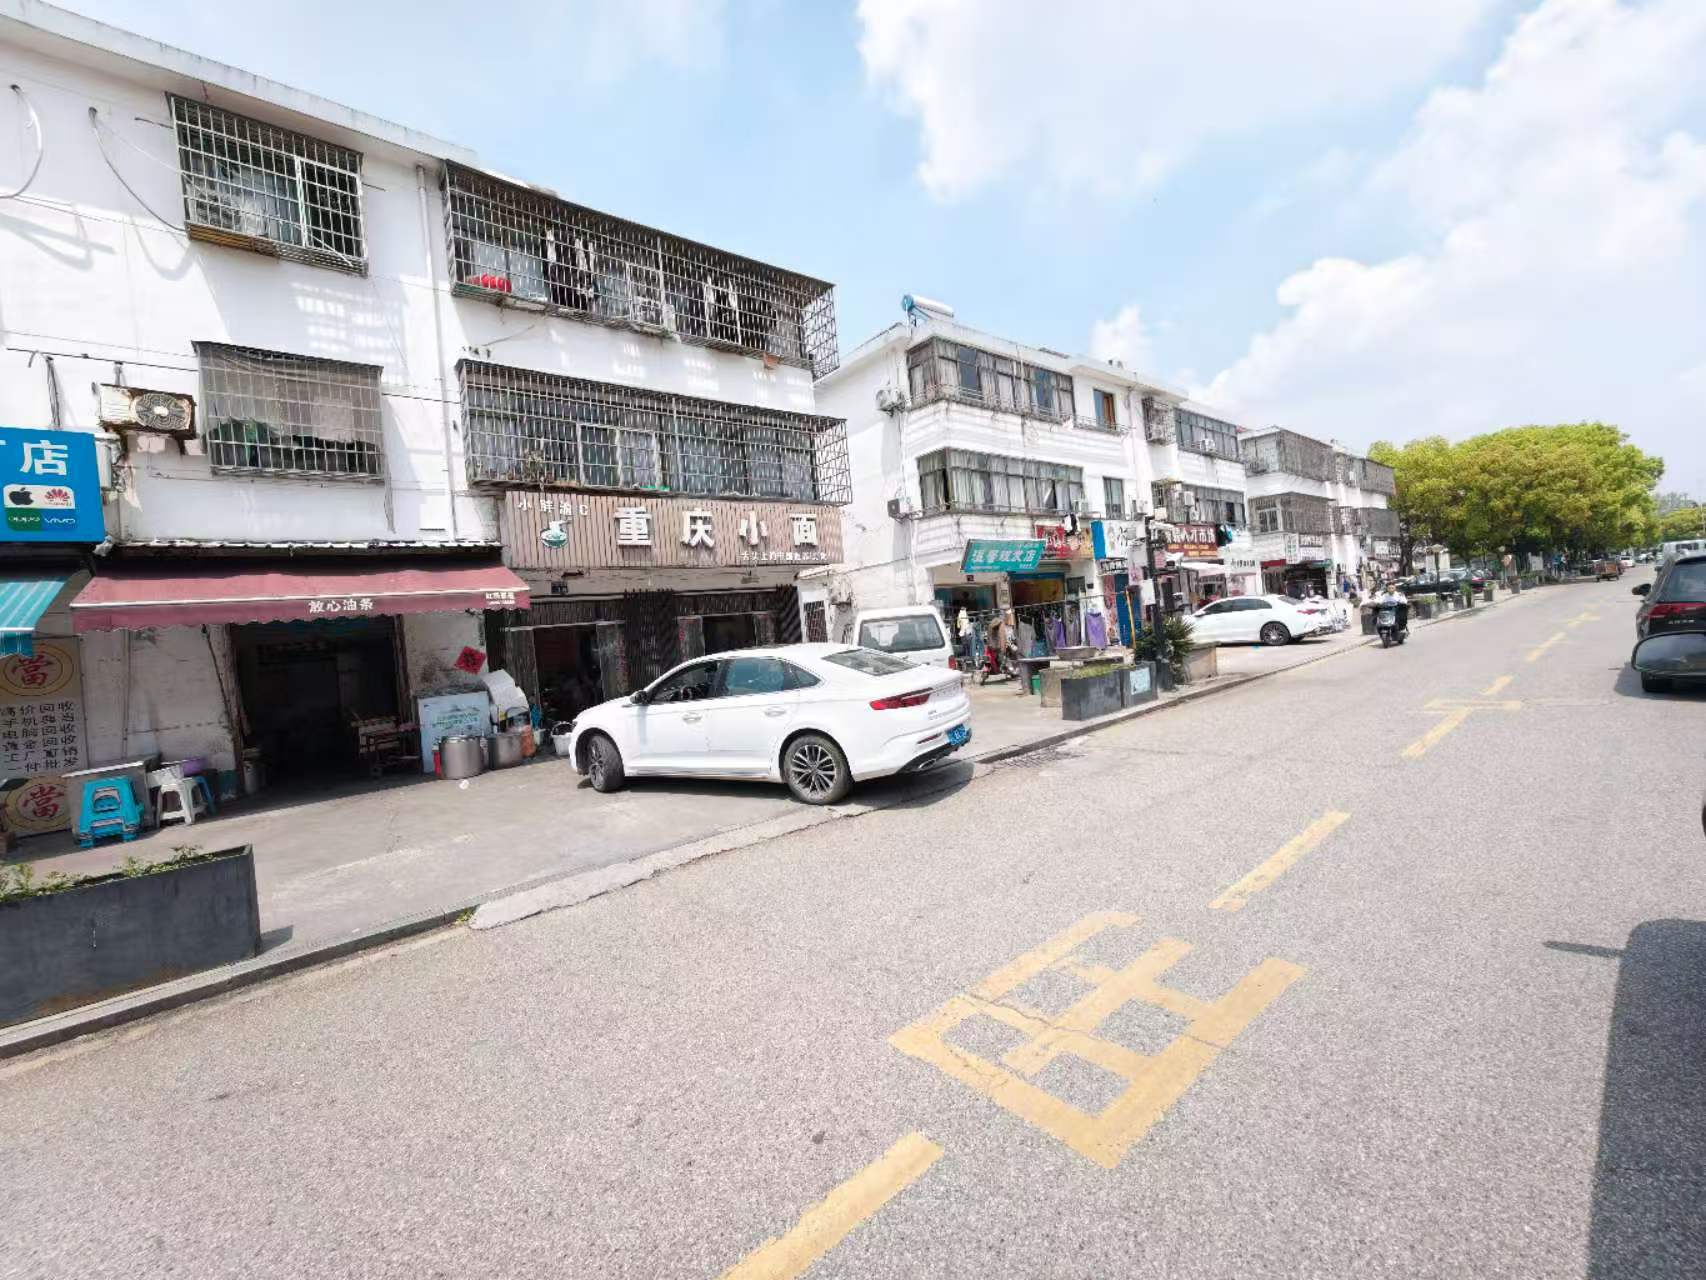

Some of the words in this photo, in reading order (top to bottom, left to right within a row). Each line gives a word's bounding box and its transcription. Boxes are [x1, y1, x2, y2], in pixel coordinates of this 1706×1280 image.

[0, 440, 68, 475] 店
[614, 506, 817, 548] 重庆小面
[308, 598, 374, 614] 放心油条
